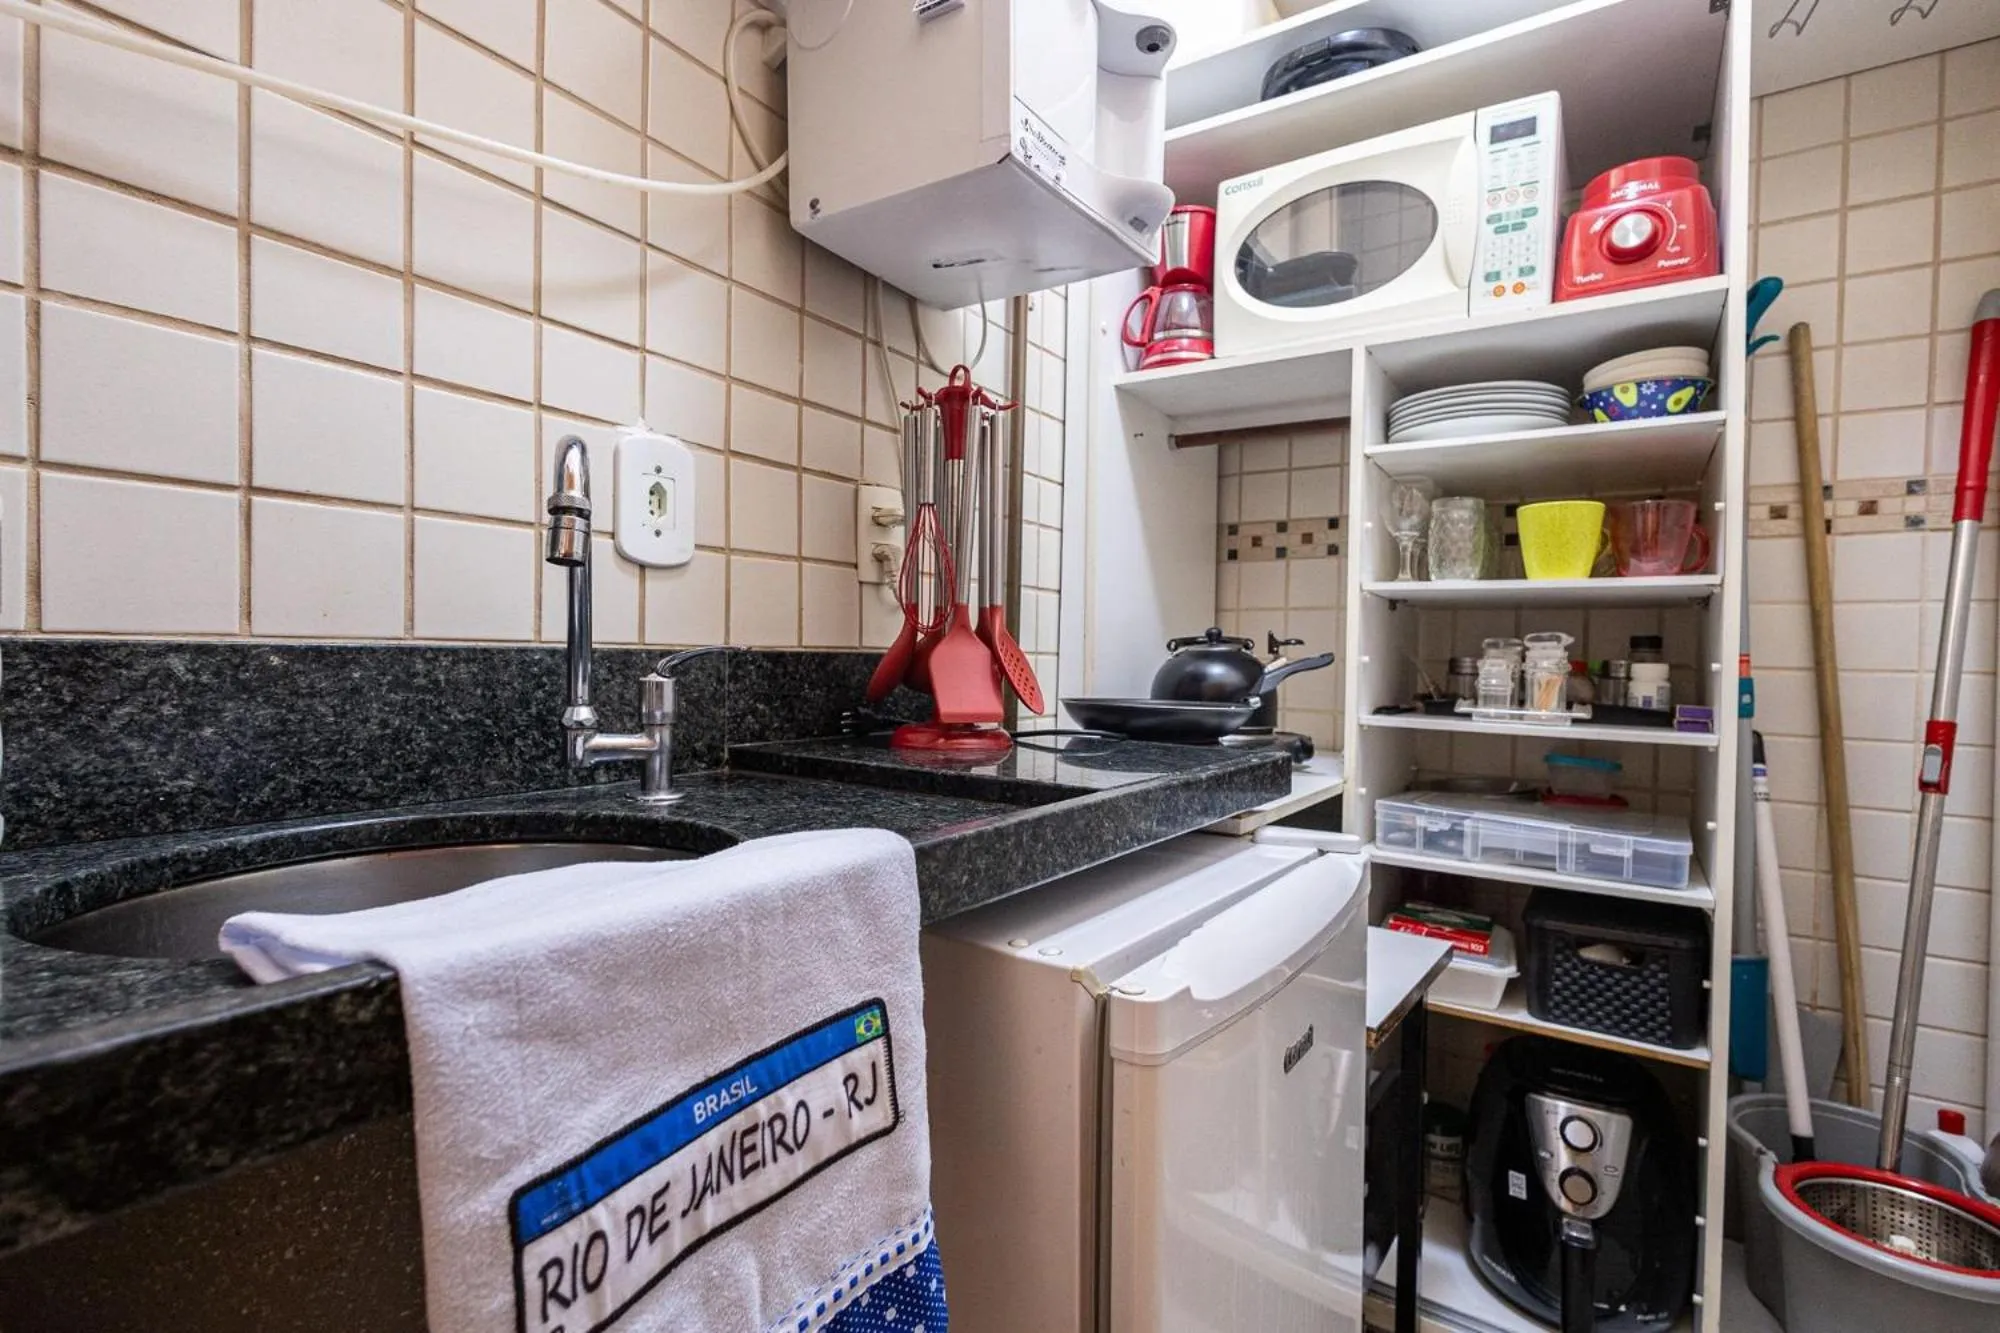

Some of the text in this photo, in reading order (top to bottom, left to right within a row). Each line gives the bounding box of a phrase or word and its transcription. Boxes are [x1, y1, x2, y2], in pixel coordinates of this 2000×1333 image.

[1224, 176, 1264, 196] consul
[1657, 256, 1691, 268] Power
[1576, 272, 1604, 284] Turbo
[692, 1075, 758, 1125] BRASIL
[538, 1229, 609, 1323] RIO
[626, 1179, 671, 1263] DE
[680, 1099, 810, 1219] JANEIRO
[842, 1060, 878, 1120] RJ
